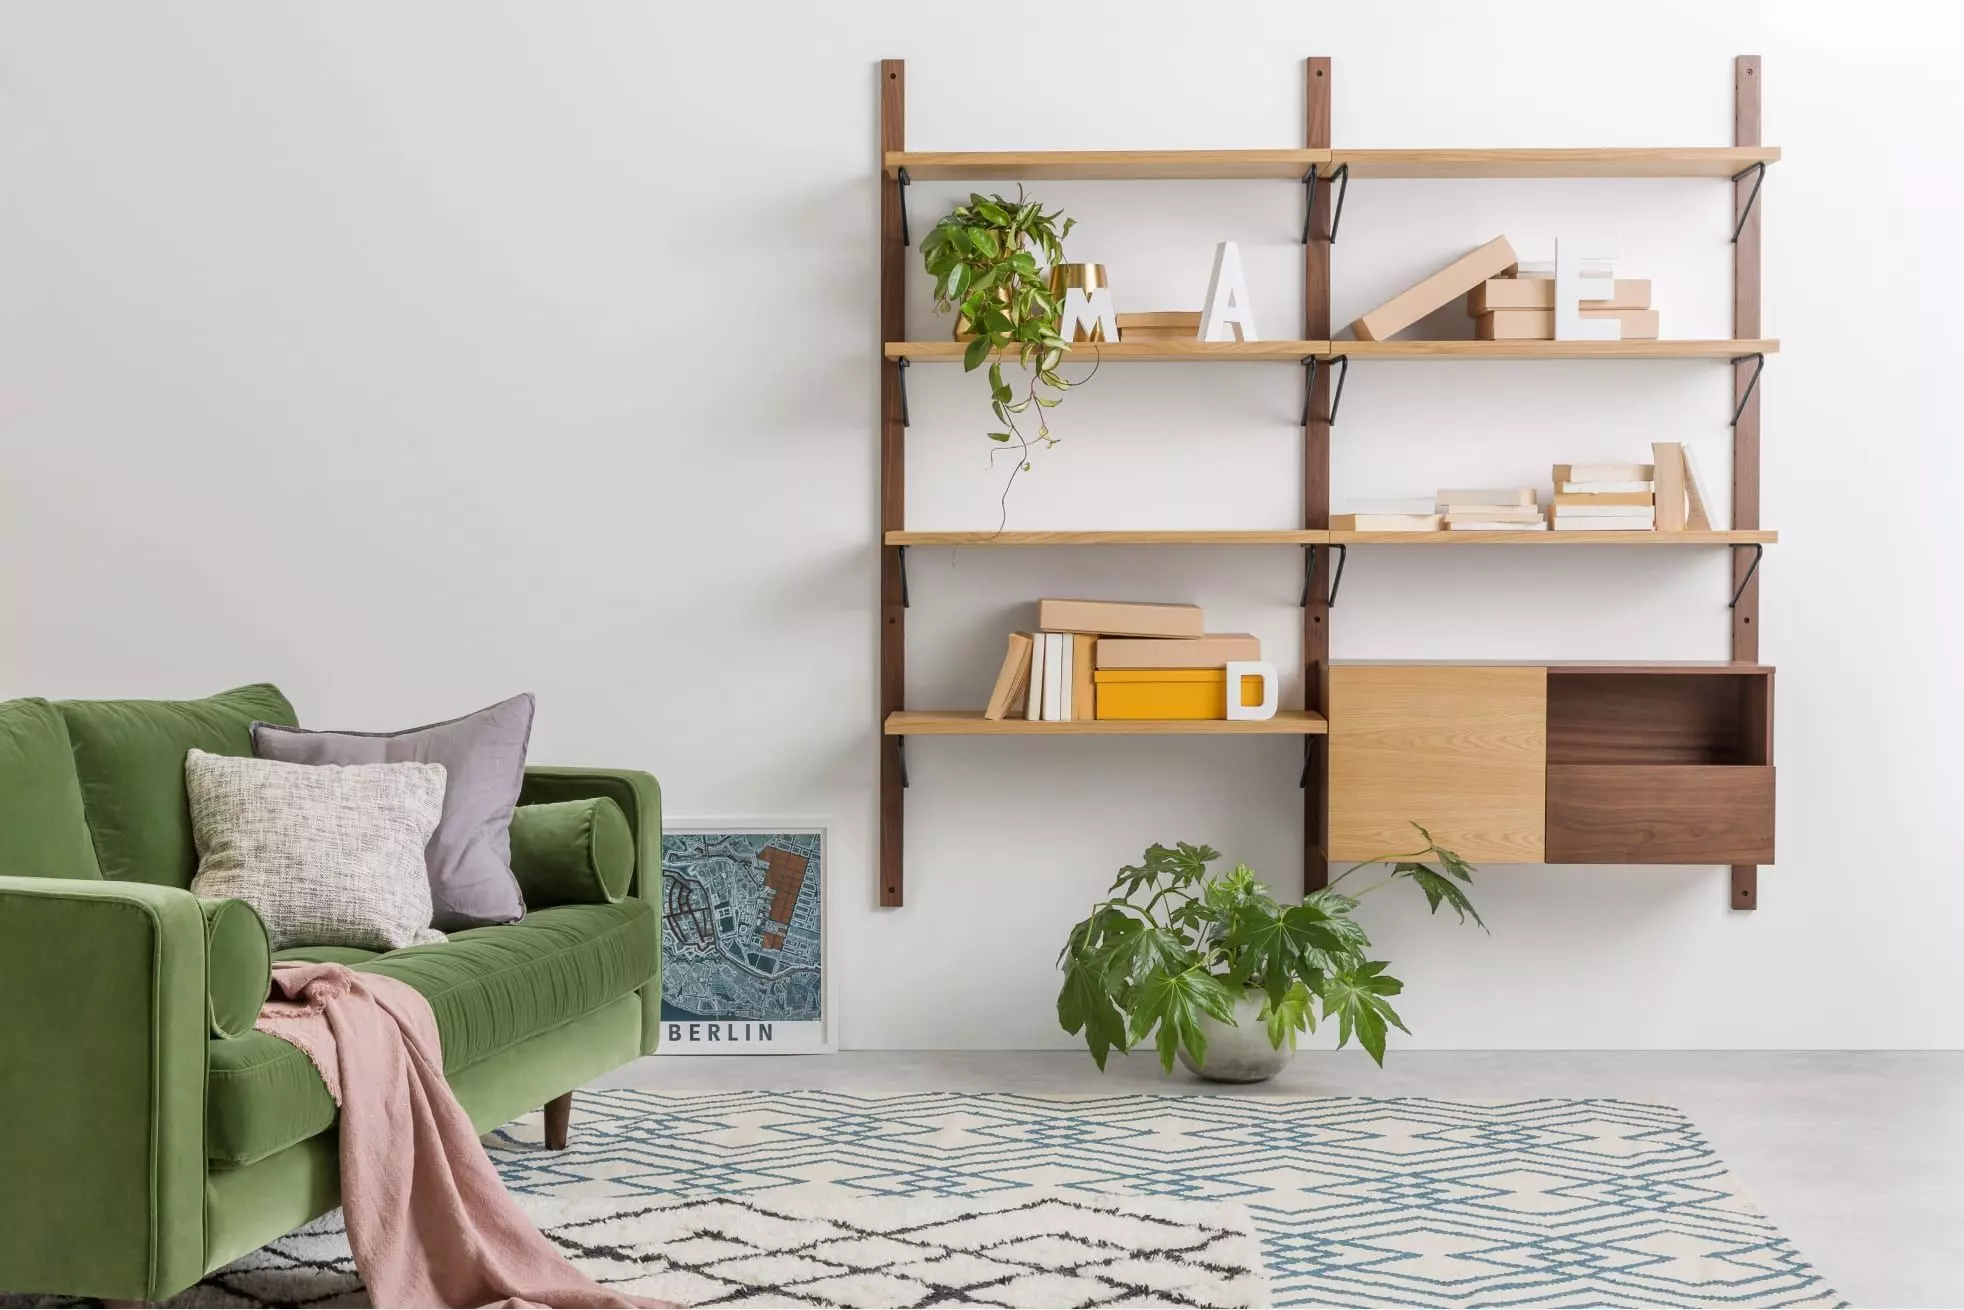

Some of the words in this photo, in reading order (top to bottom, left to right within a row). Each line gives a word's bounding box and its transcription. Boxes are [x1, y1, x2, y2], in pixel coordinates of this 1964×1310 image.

[1060, 287, 1120, 342] M
[1198, 241, 1258, 342] A
[1555, 237, 1622, 340] E
[1226, 661, 1278, 720] D
[668, 1024, 772, 1041] BERLIN
